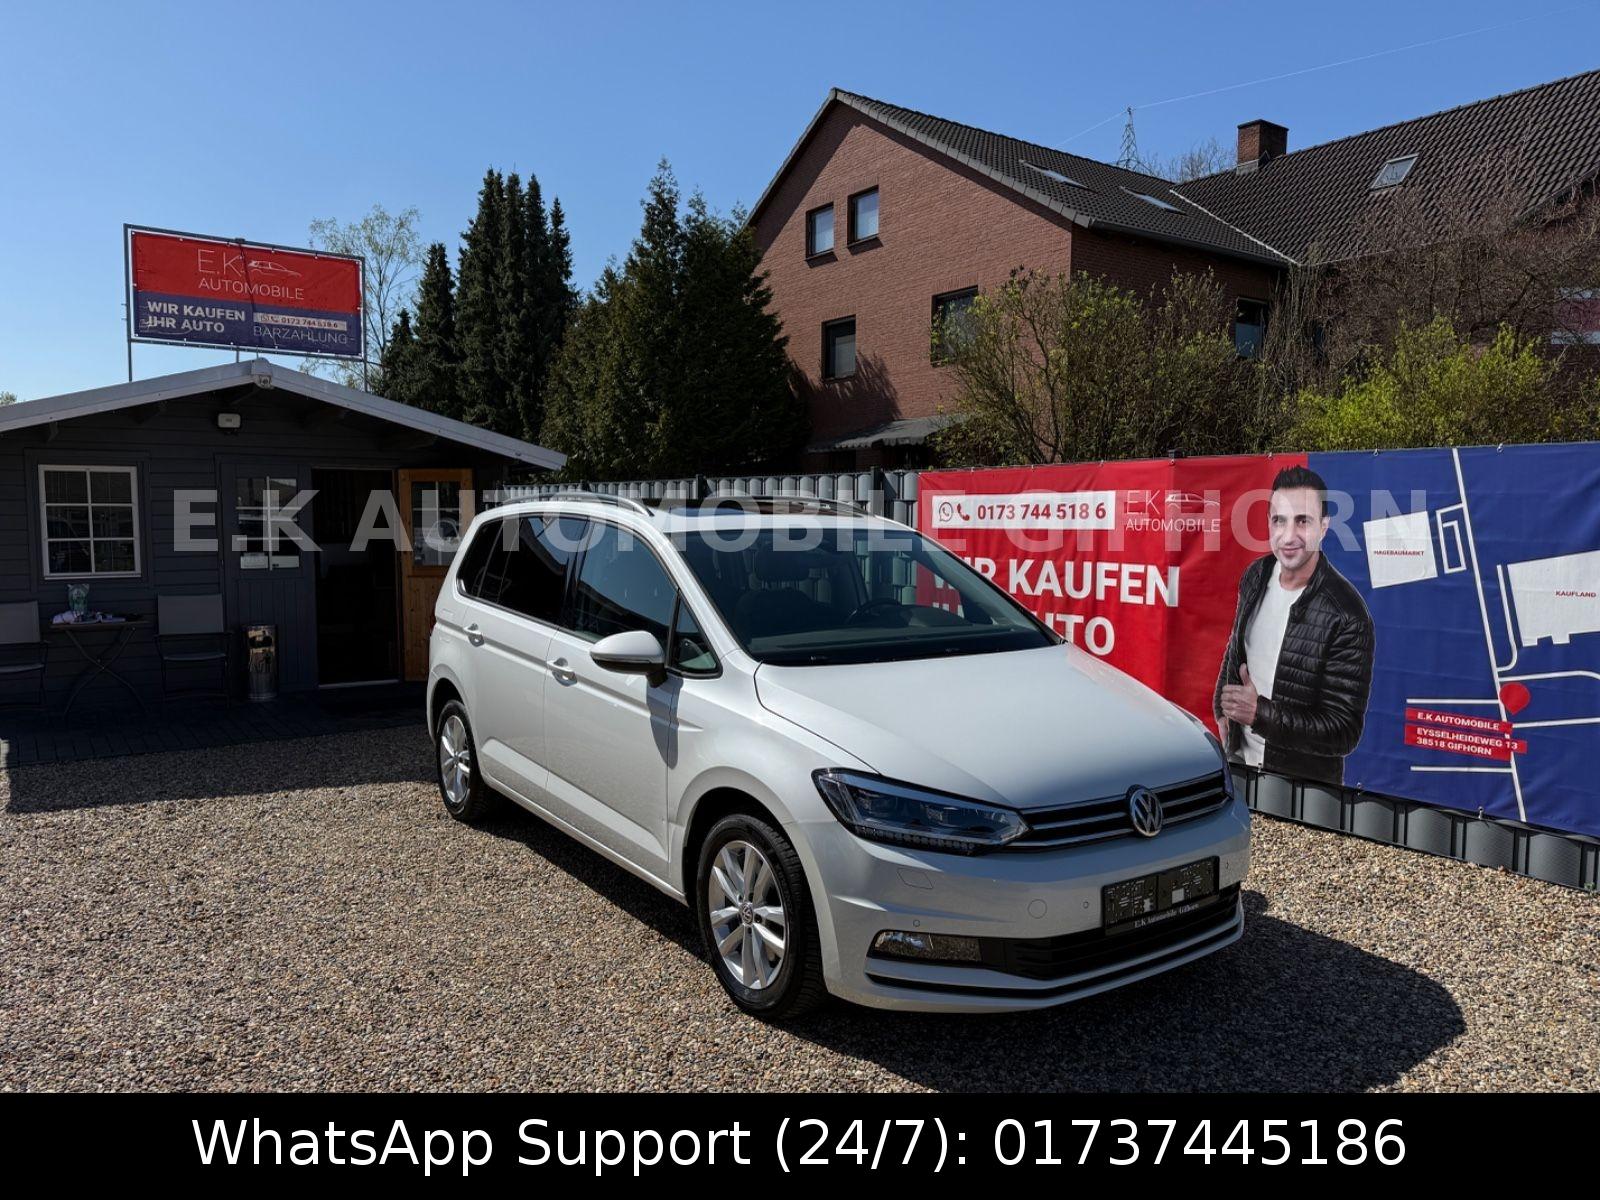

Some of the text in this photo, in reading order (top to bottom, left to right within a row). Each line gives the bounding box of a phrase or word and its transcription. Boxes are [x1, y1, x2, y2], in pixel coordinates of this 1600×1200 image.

[197, 248, 242, 276] E.K
[198, 279, 304, 300] AUTOMOBILE
[147, 301, 245, 322] WIR KAUFEN
[181, 319, 225, 334] AUTO
[253, 325, 348, 345] BARZAHLUNG
[977, 502, 1107, 521] 0173 744 518 6
[1126, 489, 1160, 515] E.K
[1125, 518, 1221, 533] AUTOMOBILE
[1373, 549, 1425, 557] HAGEBAUMARKT
[1009, 558, 1180, 608] KAUFEN
[1555, 590, 1597, 598] KAUFLAND
[1417, 712, 1500, 731] E.K AUTOMOBILE
[1416, 727, 1519, 750] EYSSELHEIDEWEG 13
[1416, 737, 1492, 756] 38518 GIFHORN
